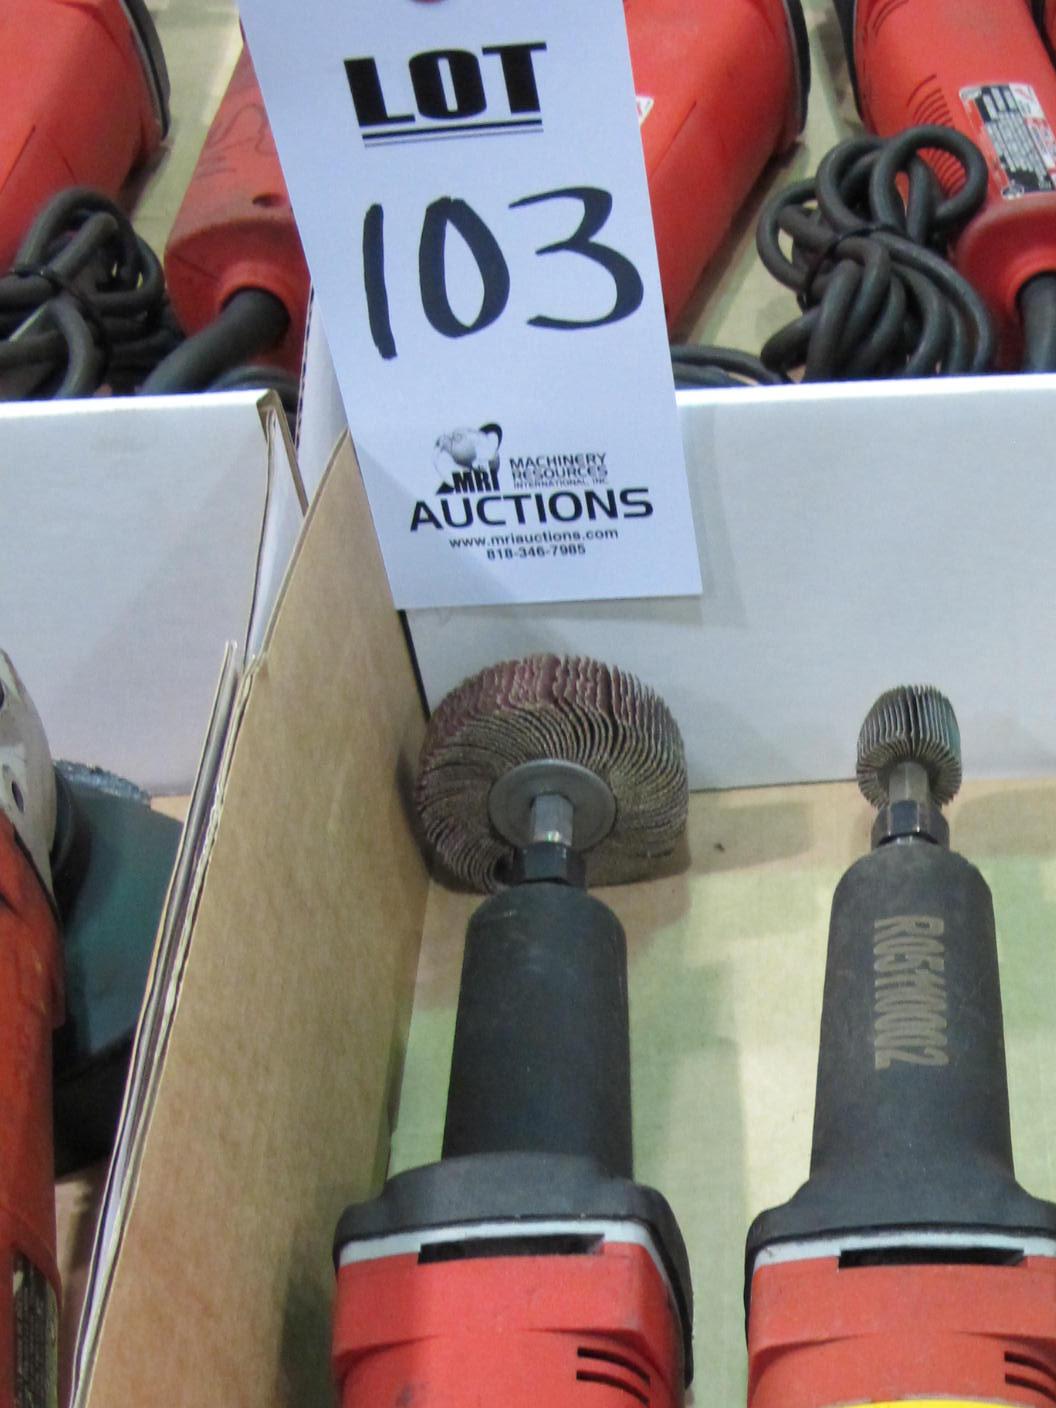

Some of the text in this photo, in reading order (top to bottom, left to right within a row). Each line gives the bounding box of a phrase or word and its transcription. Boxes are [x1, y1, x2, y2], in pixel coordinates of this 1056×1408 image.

[344, 42, 547, 128] LOT
[362, 186, 644, 360] 103
[508, 452, 607, 469] MACHINERY
[511, 465, 609, 481] RESOURCES
[410, 488, 654, 532] AUCTIONS
[448, 528, 619, 549] www.mriauctions.com
[486, 543, 587, 561] 818-346-7985
